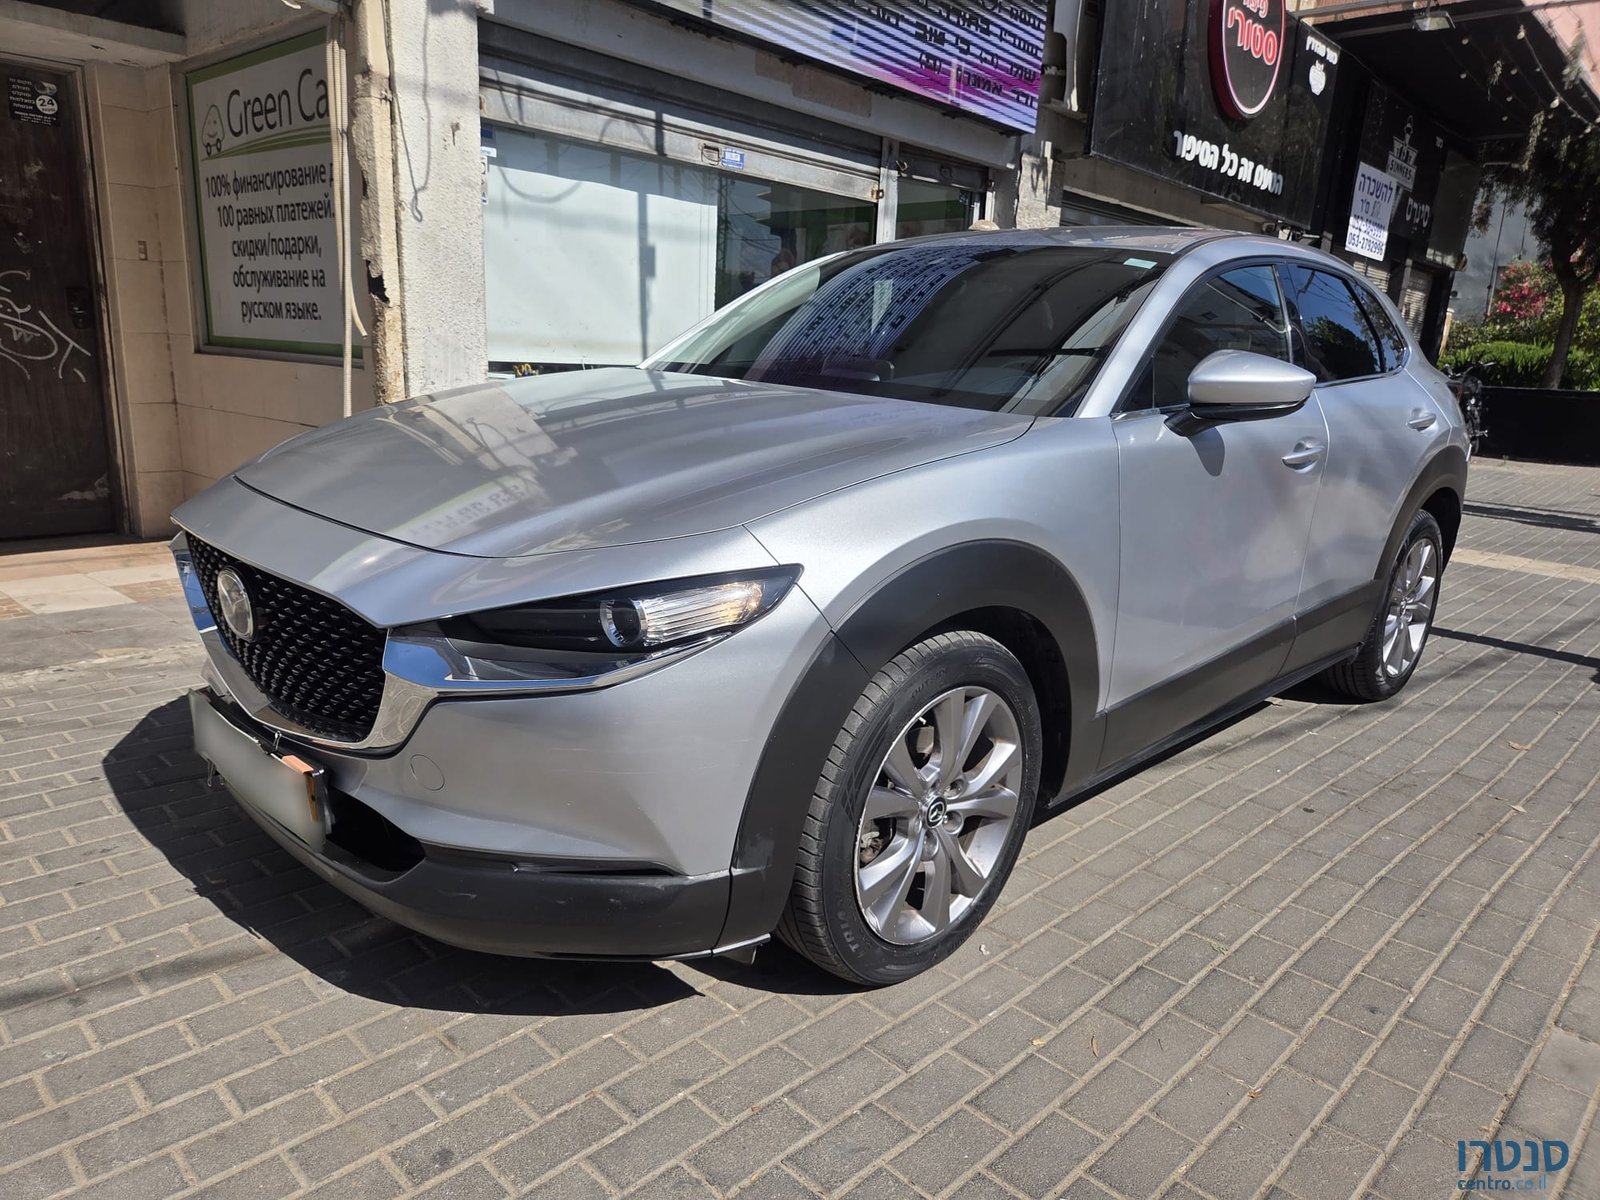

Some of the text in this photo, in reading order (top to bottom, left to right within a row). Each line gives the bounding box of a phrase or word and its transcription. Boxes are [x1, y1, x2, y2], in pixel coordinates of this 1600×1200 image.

[1228, 7, 1277, 65] סטורי
[38, 98, 55, 107] 24
[227, 88, 292, 138] Green
[1173, 130, 1284, 196] הטעם זה כל הסיפור
[205, 174, 231, 198] 100%
[232, 164, 326, 200] финансирование
[1359, 173, 1393, 203] להשכרה
[217, 192, 335, 232] 100 равных платежей.
[232, 232, 322, 261] скидки/подарки,
[233, 265, 326, 293] обслуживание на
[241, 301, 322, 323] русском языке.
